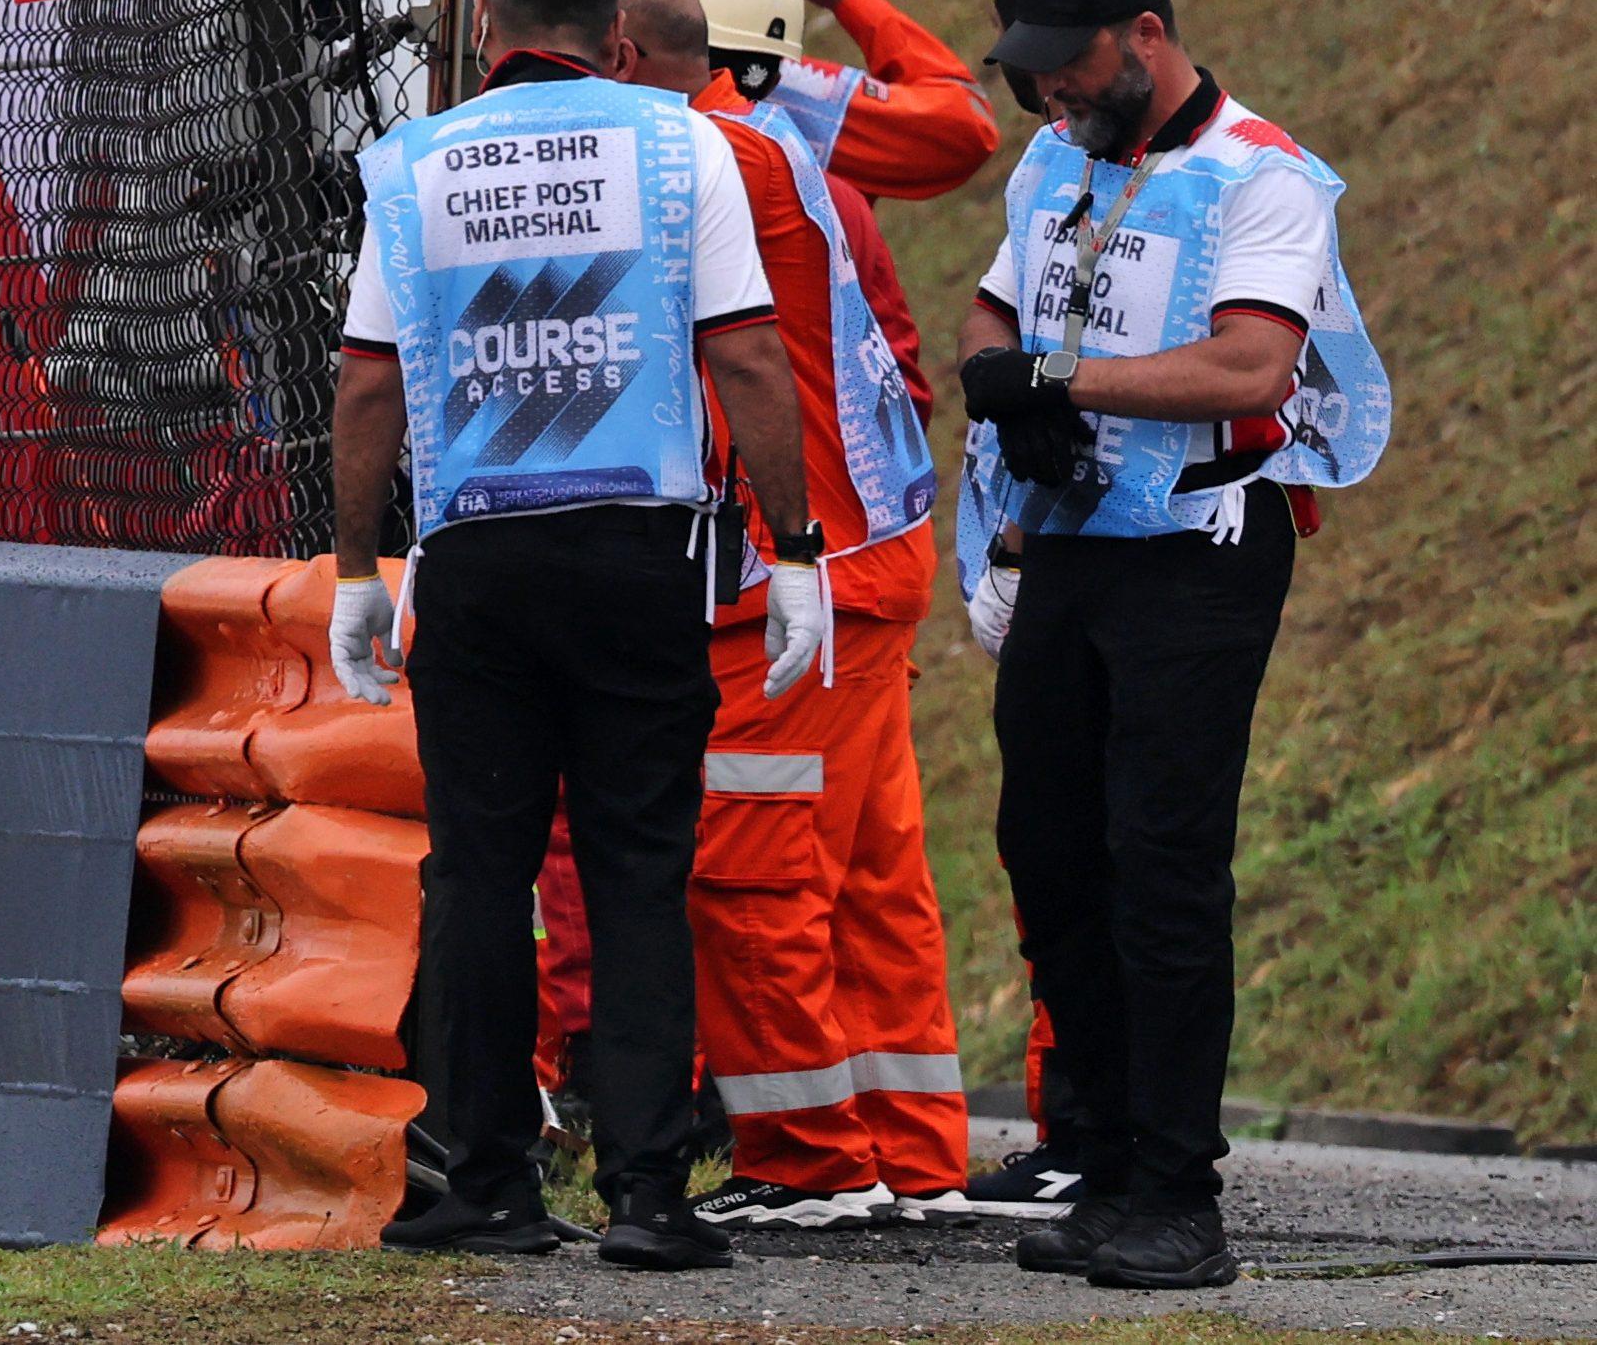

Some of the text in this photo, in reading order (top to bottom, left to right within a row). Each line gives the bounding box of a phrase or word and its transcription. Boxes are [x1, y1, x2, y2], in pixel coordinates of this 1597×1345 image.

[445, 134, 599, 172] 0382-BHR
[445, 178, 606, 217] CHIEF POST
[653, 101, 693, 283] BAHRAIN
[464, 208, 601, 244] MARSHAL
[1045, 261, 1112, 299] RAIO
[447, 311, 641, 378] COURSE
[466, 364, 622, 403] ACCESS
[693, 1192, 747, 1213] TREND
